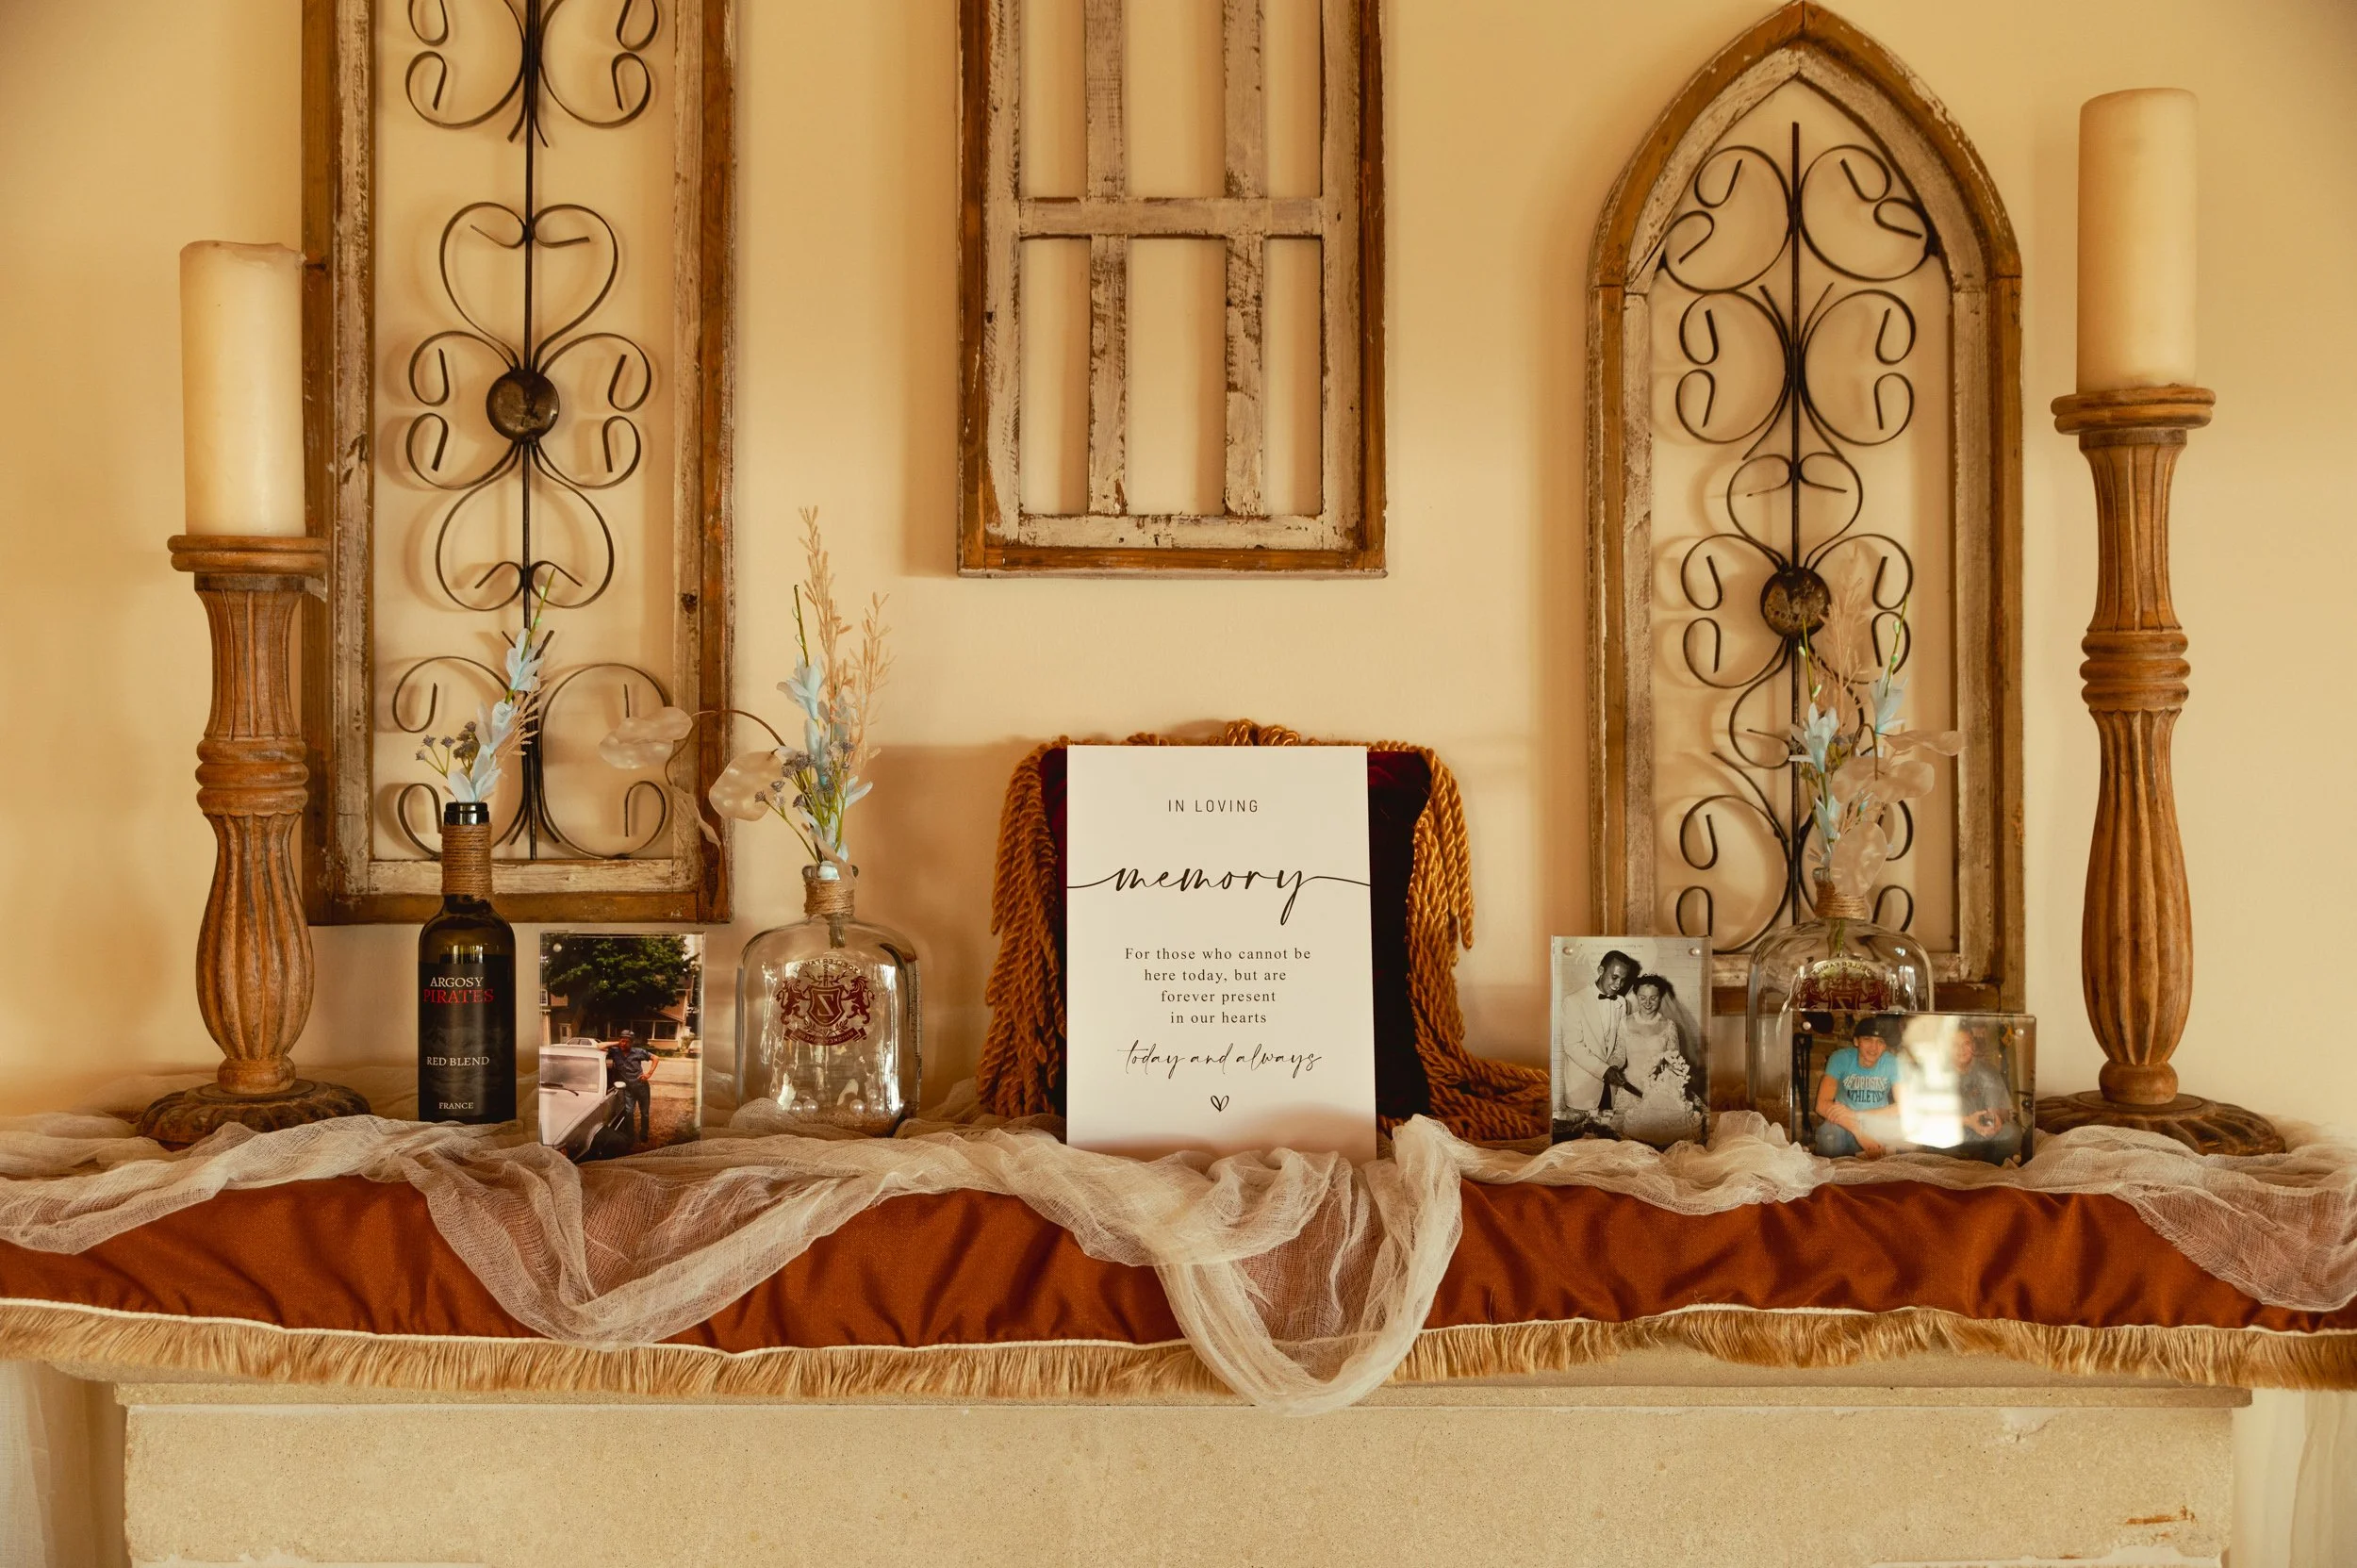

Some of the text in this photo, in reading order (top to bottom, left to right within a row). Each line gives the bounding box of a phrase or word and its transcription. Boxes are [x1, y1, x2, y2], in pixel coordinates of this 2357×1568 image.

[1168, 799, 1258, 813] IN LOVING
[1098, 867, 1325, 926] memory
[1126, 948, 1310, 960] For those who cannot be
[430, 977, 484, 988] ARGOSY
[1145, 969, 1286, 984] here today, but are
[423, 989, 494, 1004] PIRATES
[1162, 991, 1276, 1005] forever present
[1171, 1012, 1267, 1024] in our hearts
[427, 1056, 489, 1066] RED BLEND
[1117, 1040, 1322, 1079] today and always
